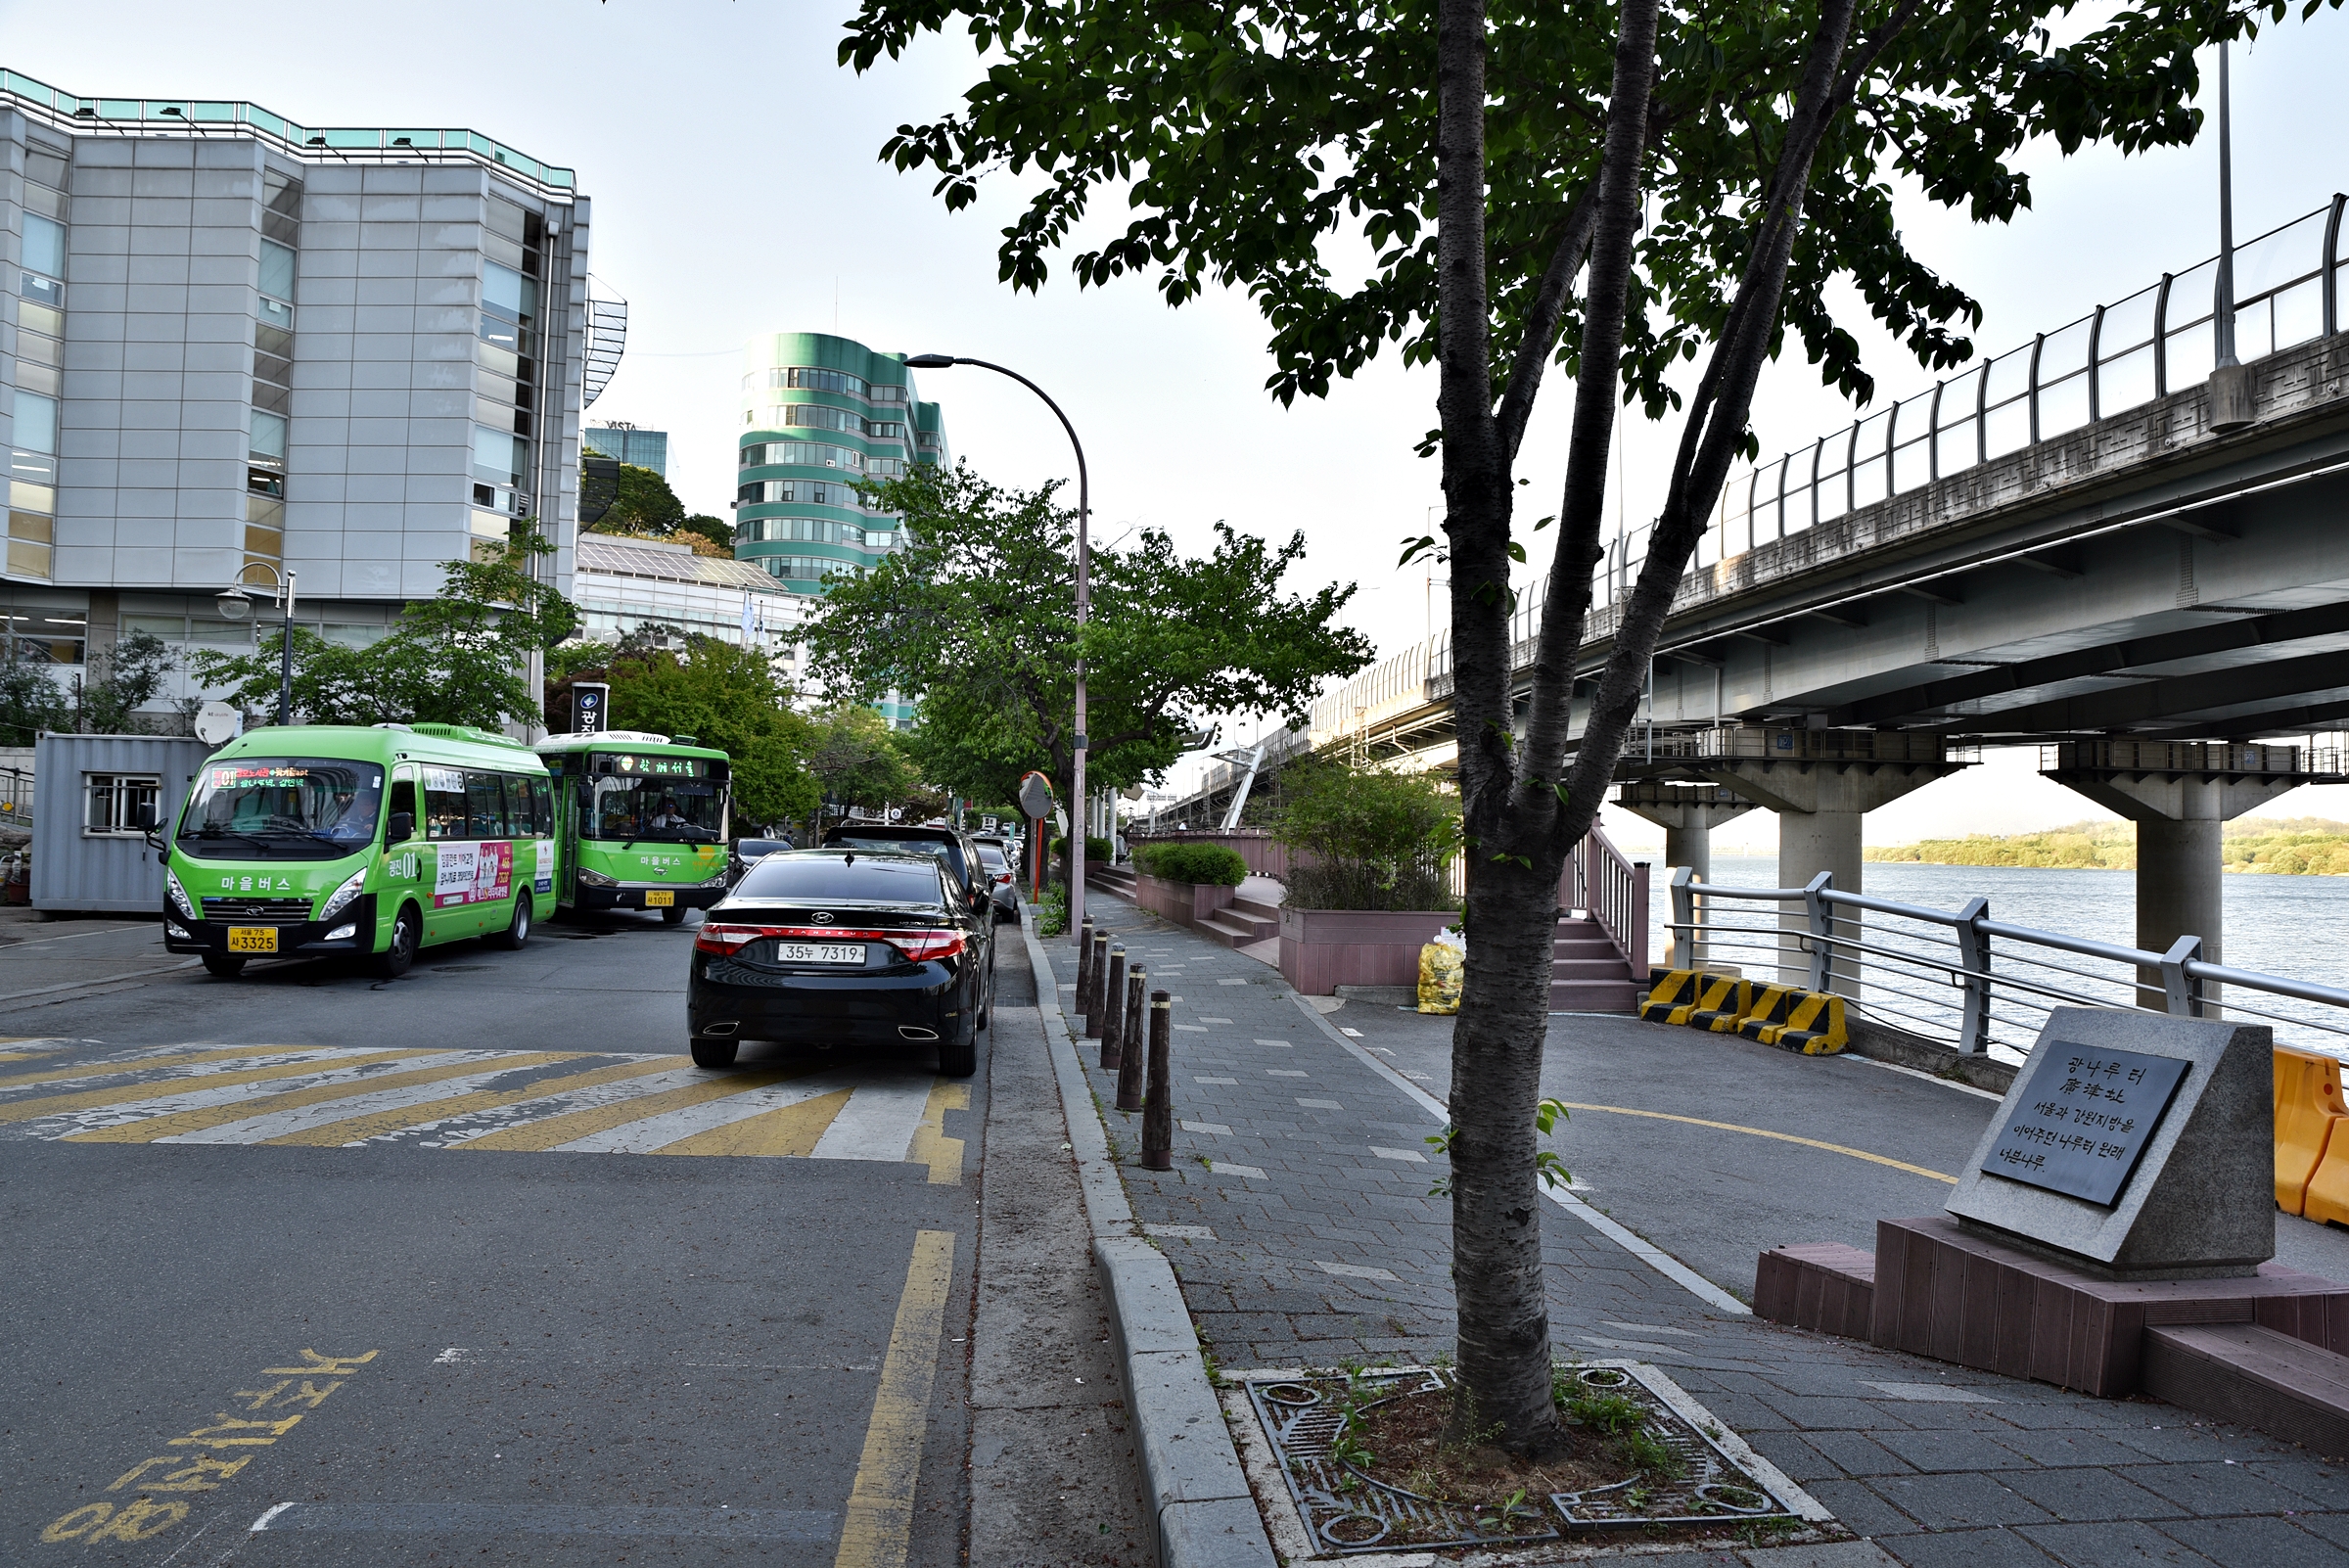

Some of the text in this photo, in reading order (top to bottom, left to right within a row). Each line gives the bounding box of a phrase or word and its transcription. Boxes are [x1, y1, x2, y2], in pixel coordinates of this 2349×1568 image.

[606, 420, 637, 431] VISTA
[389, 852, 417, 879] 광진 01
[640, 856, 681, 866] 마을버스
[221, 876, 291, 892] 마을버스
[786, 945, 857, 960] 35누 7319
[2034, 1101, 2135, 1133] 서울과 강원지방을
[2013, 1125, 2126, 1161] 이어주던 나루터 원래
[41, 1347, 381, 1545] 거주자전용
